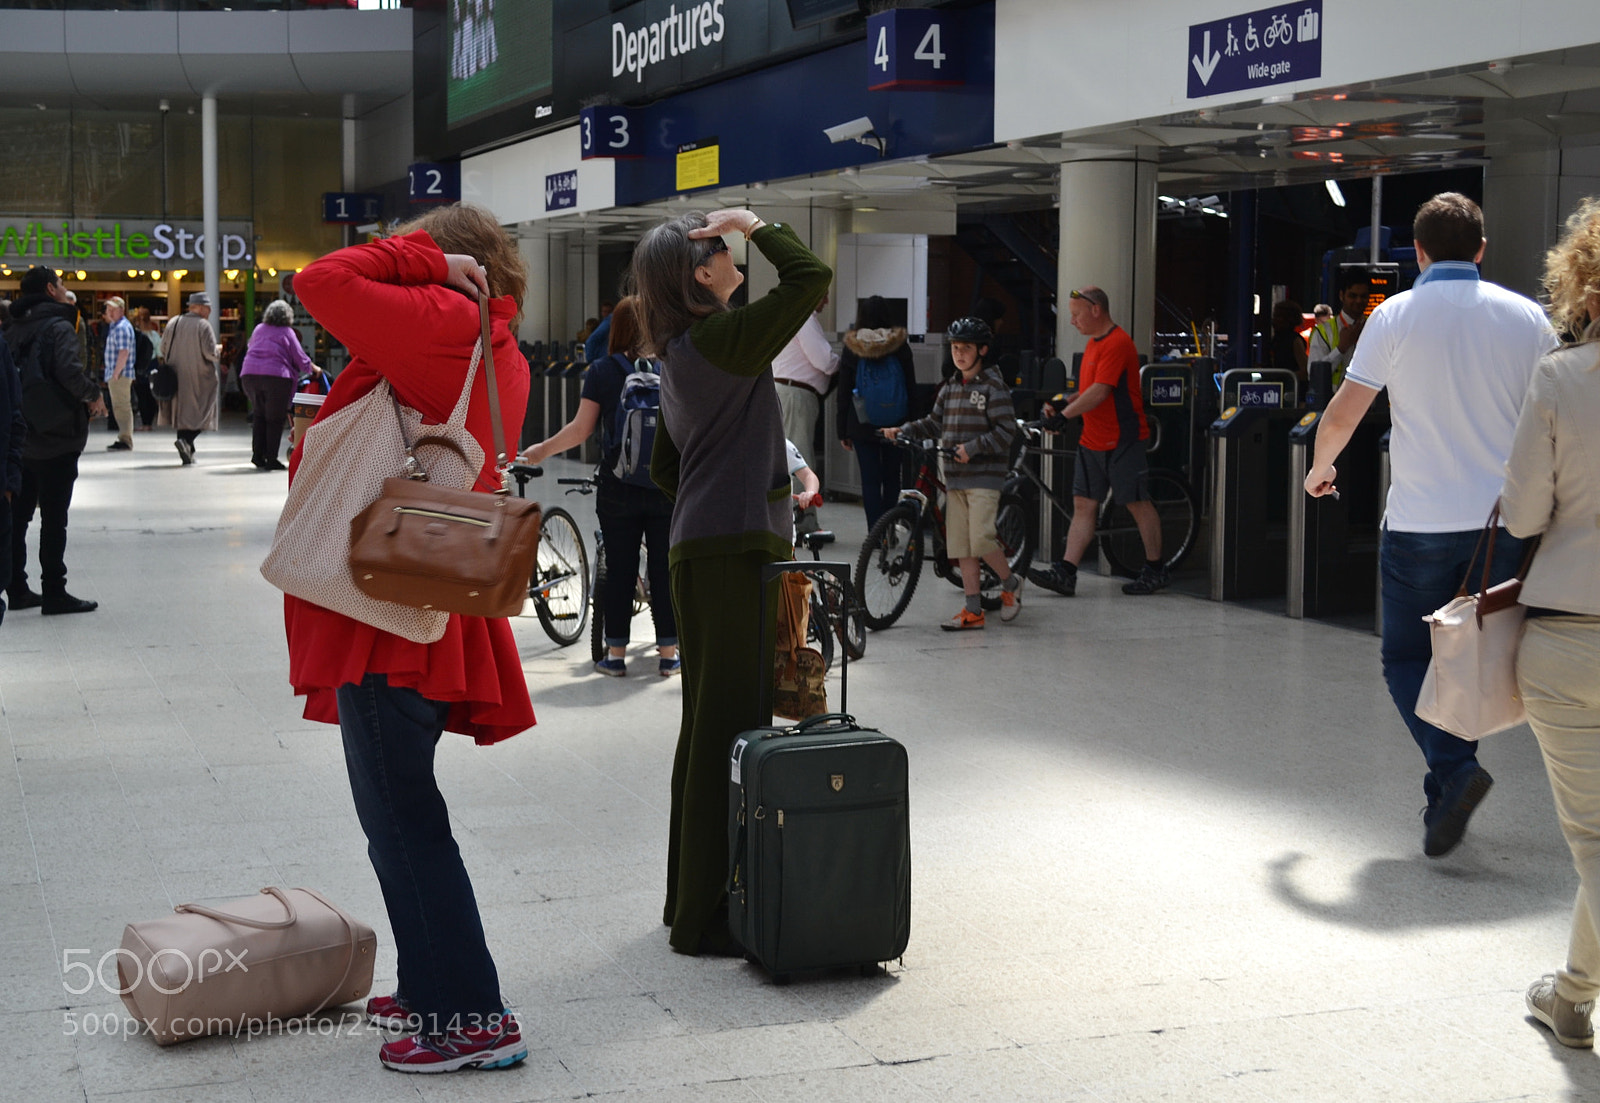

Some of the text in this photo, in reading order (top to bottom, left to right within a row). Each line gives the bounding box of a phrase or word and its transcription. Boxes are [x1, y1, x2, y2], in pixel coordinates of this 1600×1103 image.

[612, 0, 725, 83] Departures
[874, 26, 889, 72] 4
[914, 23, 946, 69] 4
[1247, 60, 1291, 79] Wide gate
[583, 116, 592, 150] 3
[608, 115, 630, 148] 3
[425, 169, 443, 194] 2
[336, 198, 349, 218] 1
